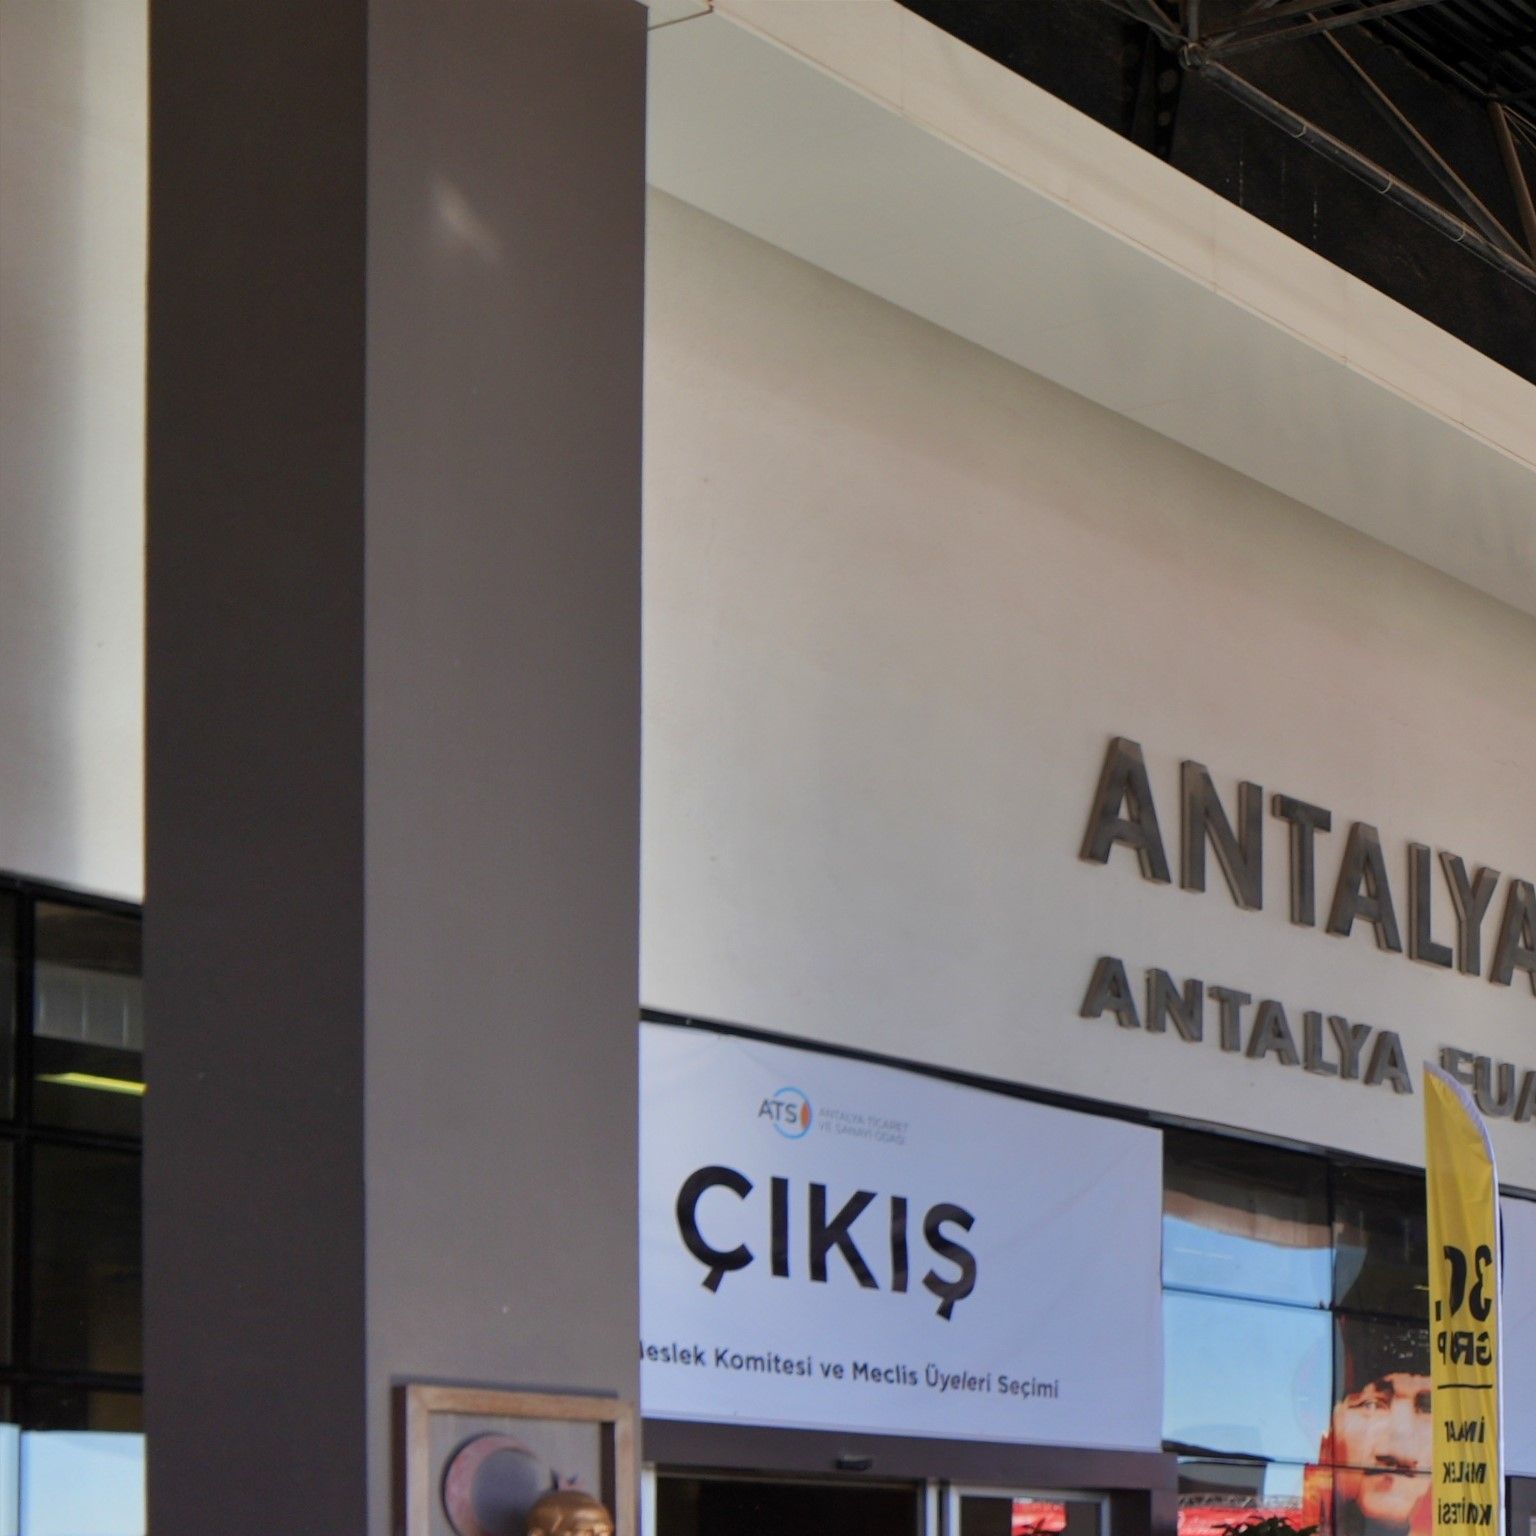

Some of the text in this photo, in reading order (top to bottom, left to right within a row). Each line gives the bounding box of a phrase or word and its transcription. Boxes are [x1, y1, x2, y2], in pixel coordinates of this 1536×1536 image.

[1080, 955, 1412, 1095] ANTALYA
[676, 1165, 977, 1321] ÇIKIŞ
[714, 1347, 812, 1378] Komitesi
[820, 1359, 844, 1380] ve
[852, 1360, 918, 1387] Meclis
[926, 1363, 991, 1394] Üyeleri
[998, 1374, 1059, 1400] Seçimi
